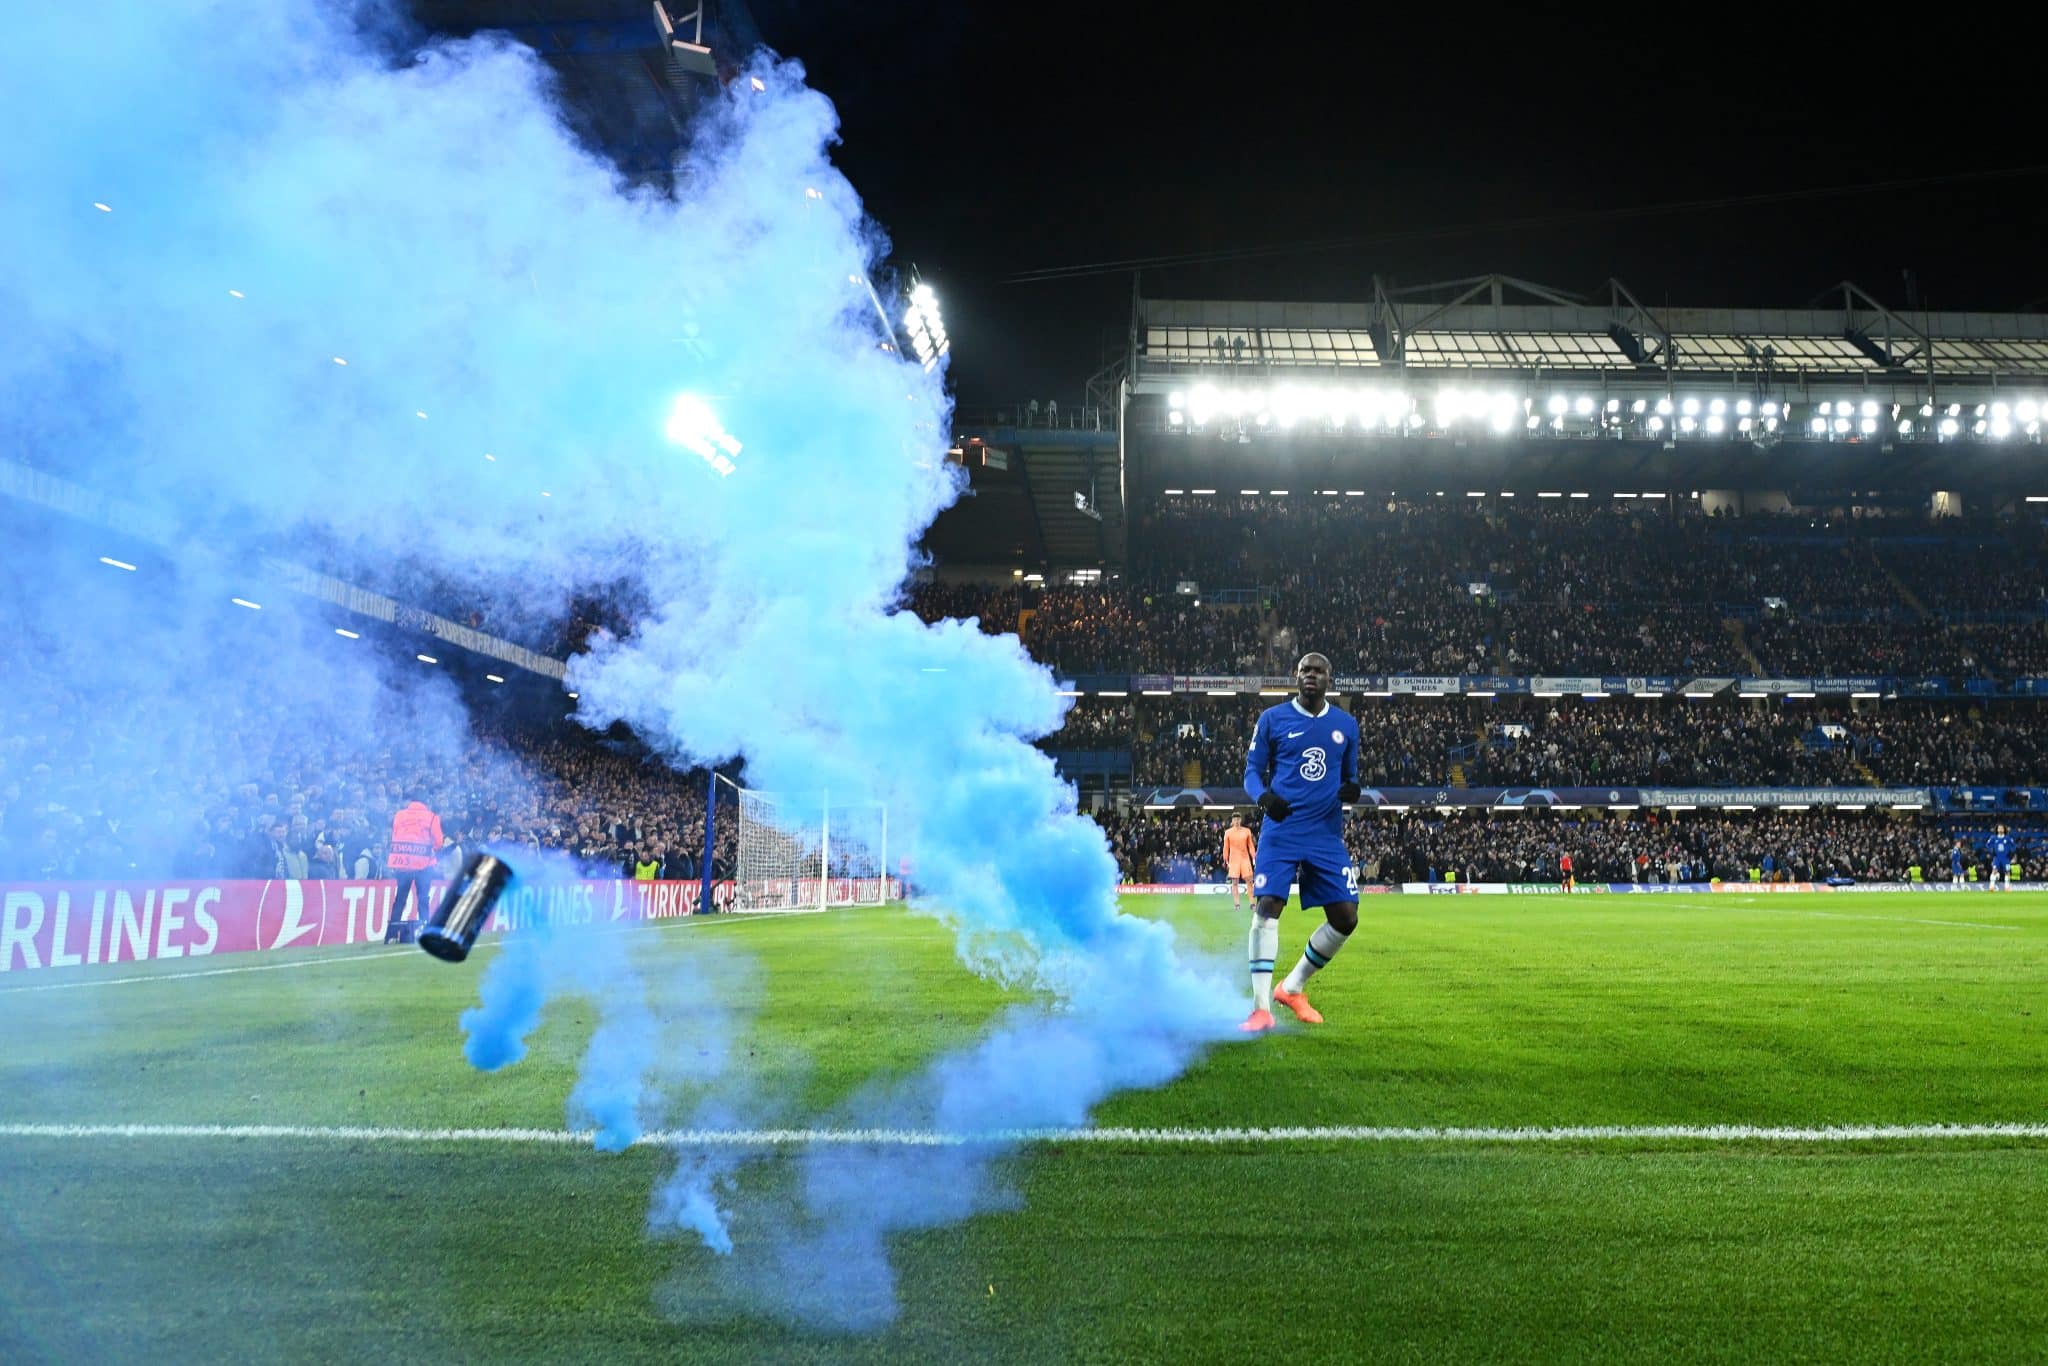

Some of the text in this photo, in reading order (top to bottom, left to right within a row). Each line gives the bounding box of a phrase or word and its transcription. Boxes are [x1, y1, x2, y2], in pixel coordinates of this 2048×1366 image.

[436, 619, 474, 648] SUPER
[476, 632, 526, 667] FRANKIE
[1334, 677, 1370, 686] CHELSEA
[1299, 746, 1327, 781] 3
[1665, 793, 1697, 803] THEY
[1735, 792, 1770, 803] MAKE
[1771, 792, 1806, 803] THEM
[1806, 792, 1832, 803] LIKE
[1832, 791, 1856, 802] RAY
[1856, 791, 1915, 802] ANYMORE
[1838, 881, 1909, 893] mastercard
[492, 883, 595, 932] AIRLINES
[0, 886, 221, 970] RLINES
